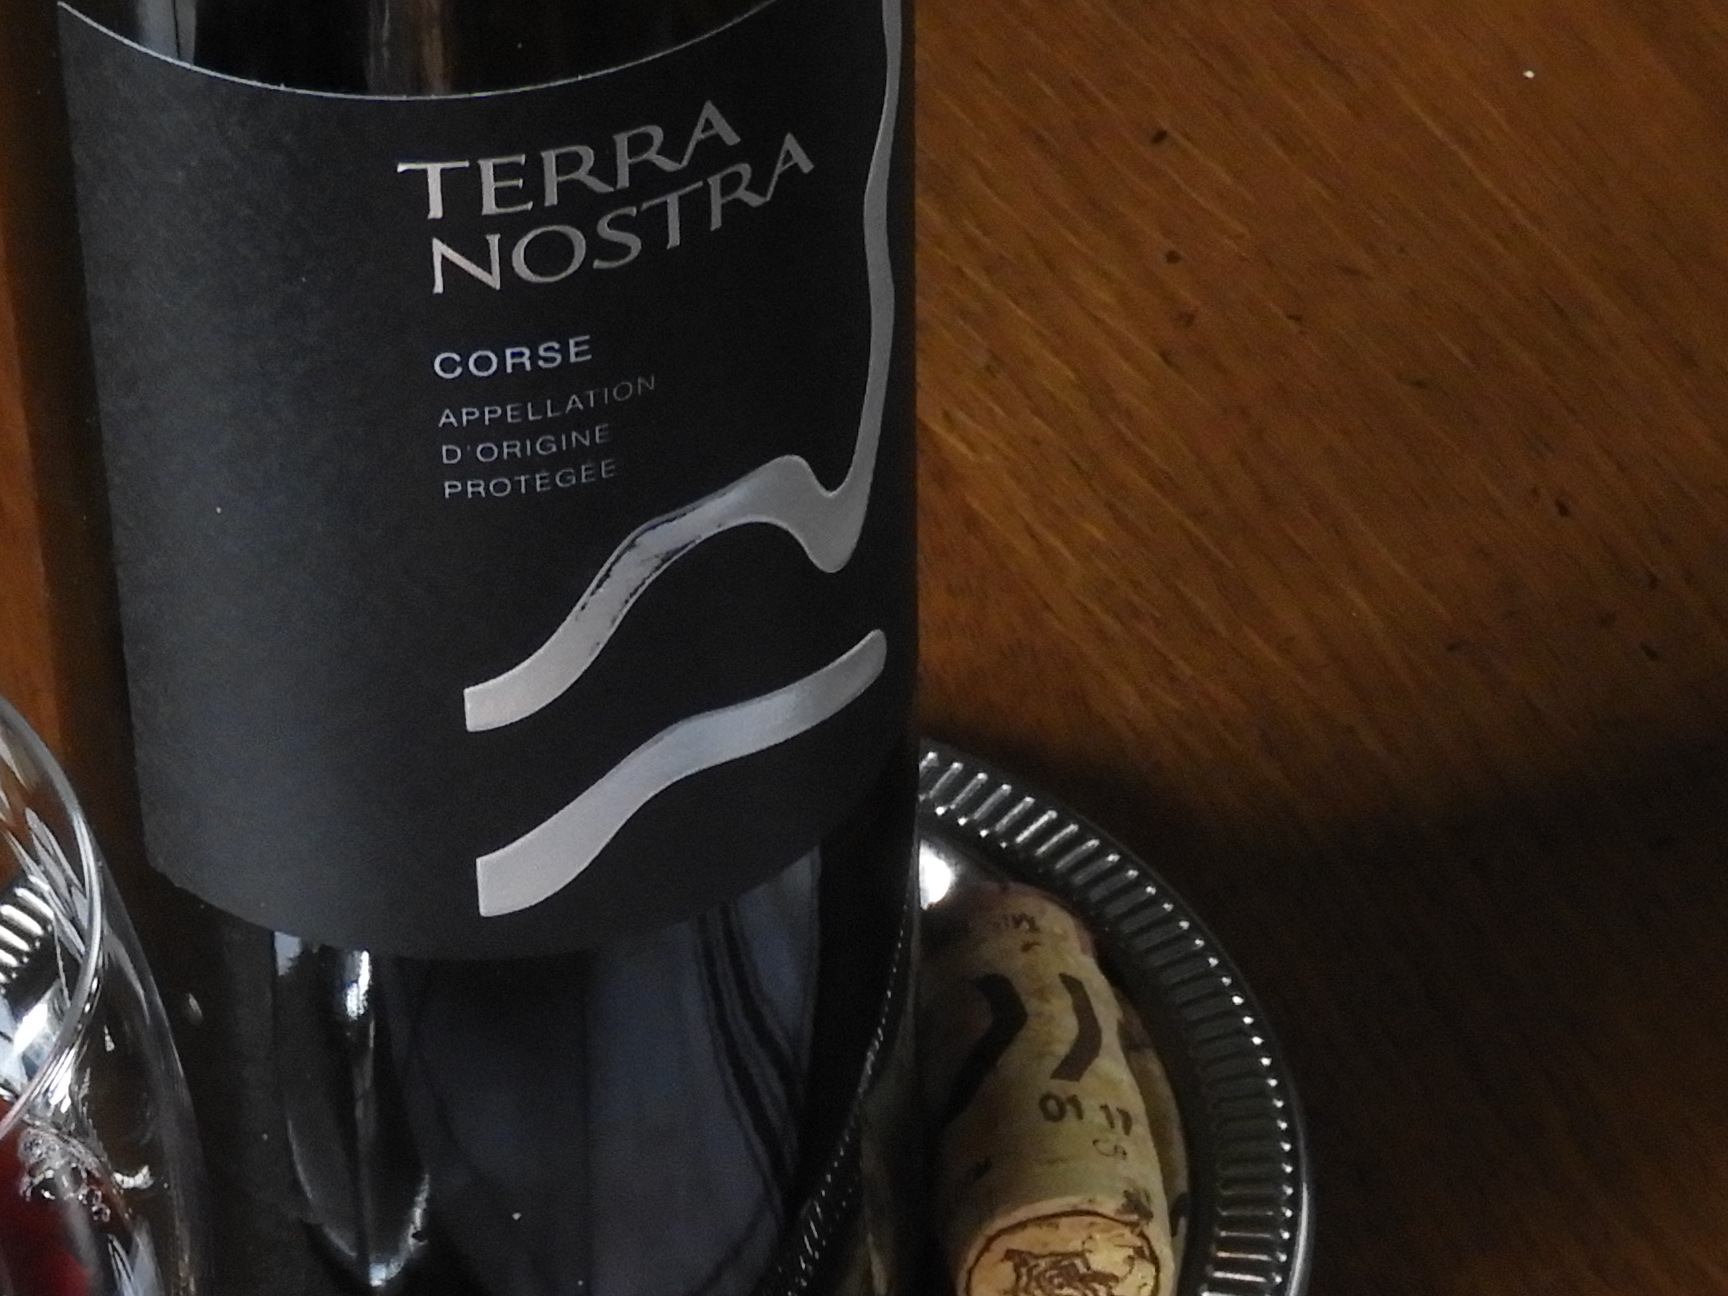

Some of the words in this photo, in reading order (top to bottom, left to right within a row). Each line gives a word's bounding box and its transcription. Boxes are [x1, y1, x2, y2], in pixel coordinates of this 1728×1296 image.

[397, 100, 741, 220] TERRA
[431, 132, 815, 295] NOSTRA
[433, 334, 593, 380] CORSE
[437, 373, 656, 428] APPELLATION
[441, 423, 611, 465] D'ORIGINE
